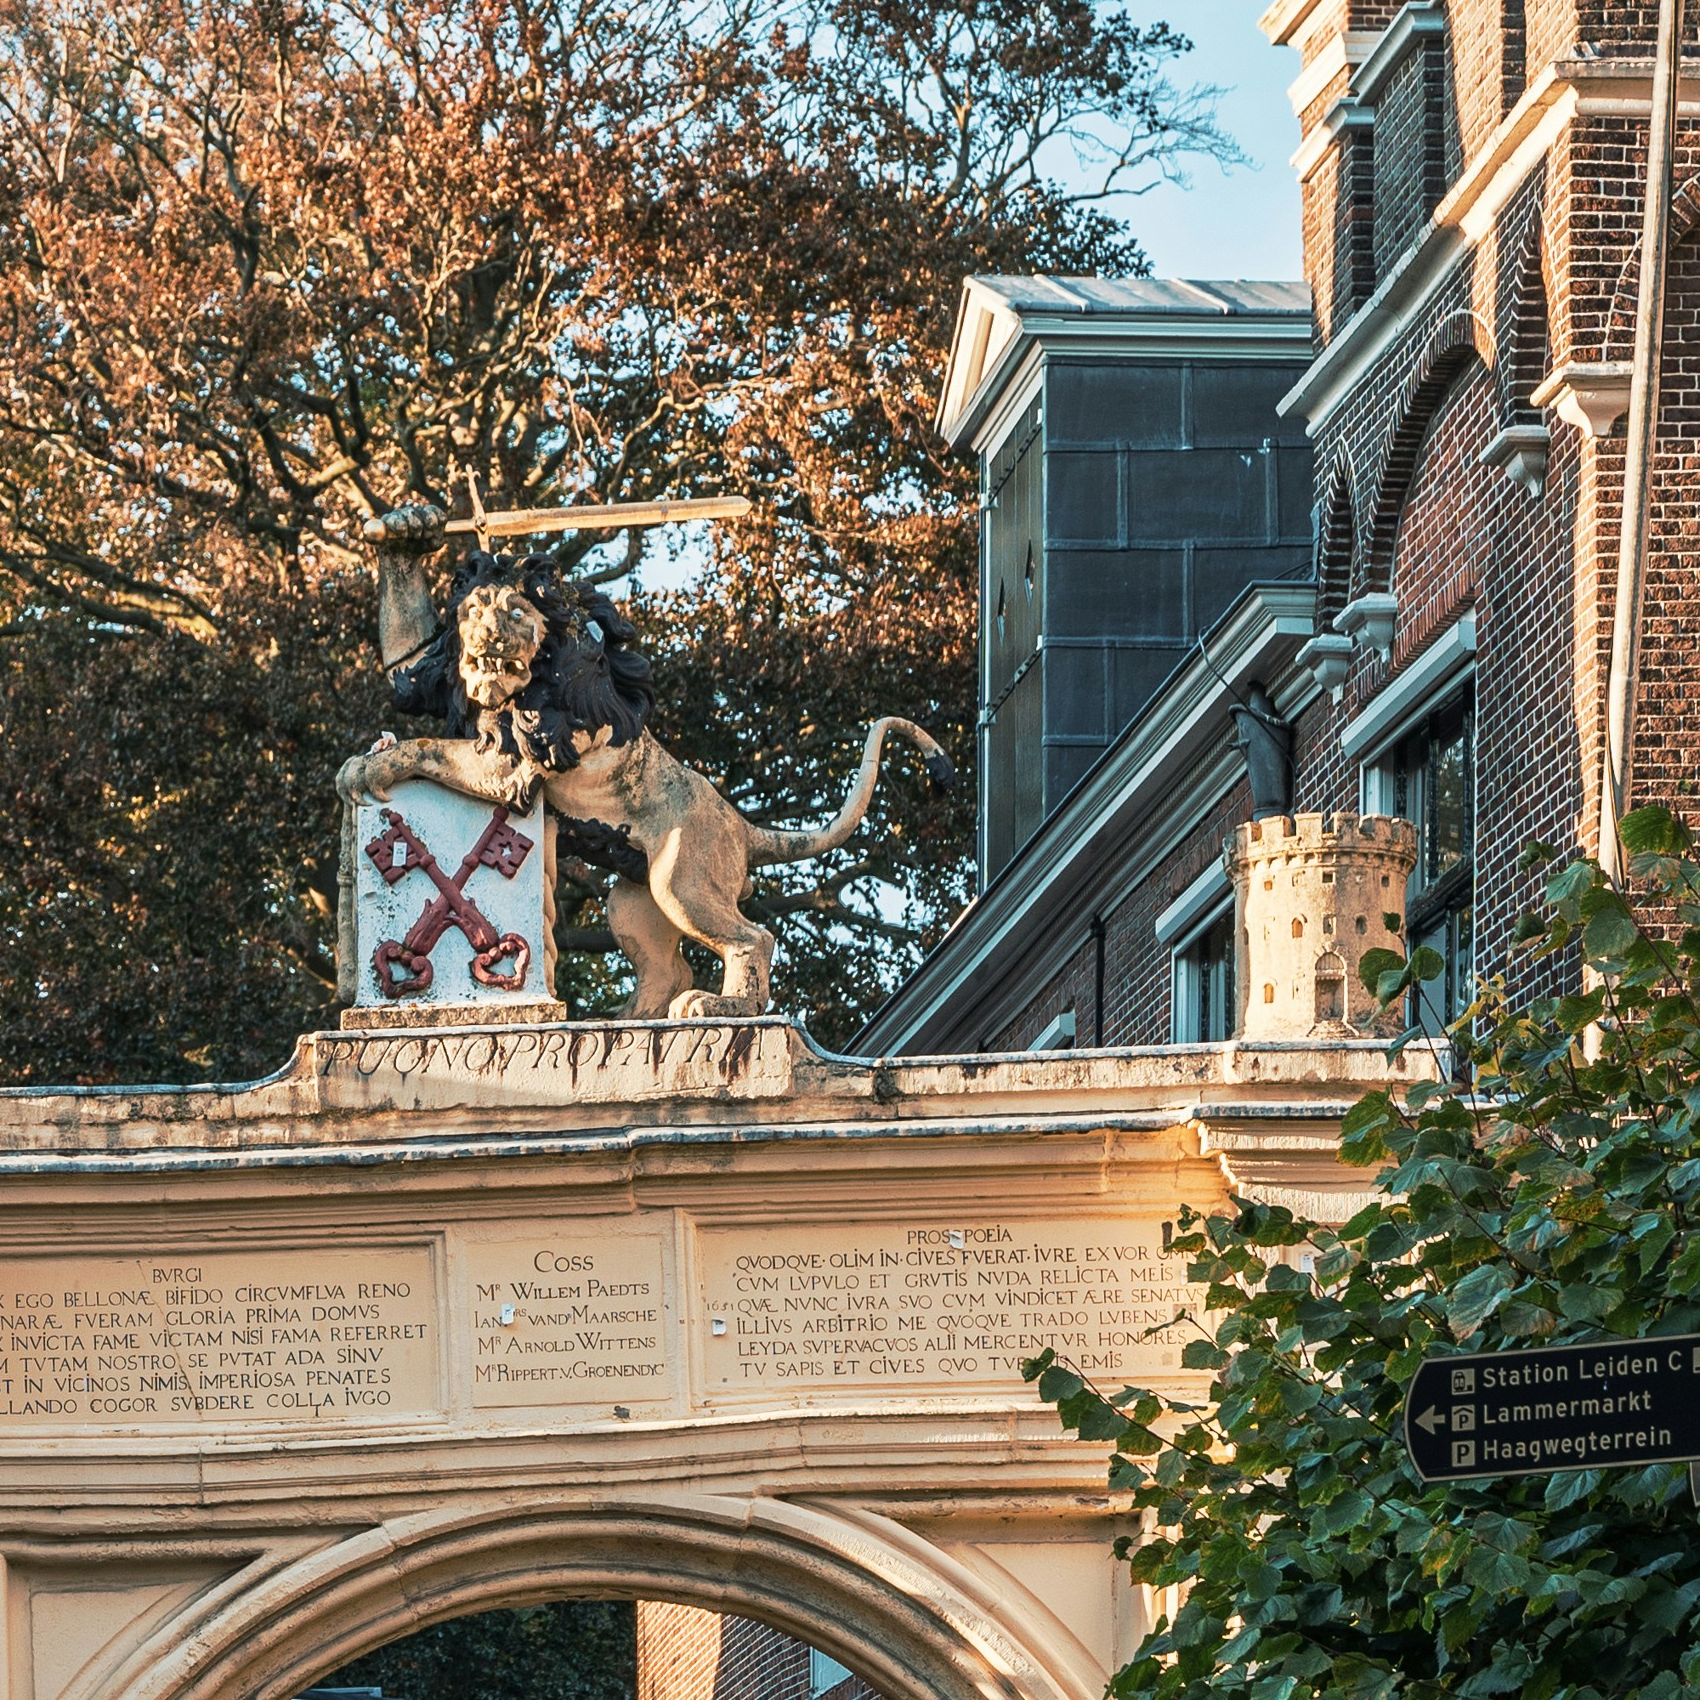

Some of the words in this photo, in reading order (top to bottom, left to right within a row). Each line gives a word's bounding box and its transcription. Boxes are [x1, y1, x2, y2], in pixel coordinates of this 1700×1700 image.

[907, 1225, 1013, 1245] PROSPOEIA
[152, 1268, 202, 1284] BVRGI
[736, 1277, 779, 1292] CVM
[789, 1275, 860, 1291] LVPVLO
[869, 1274, 890, 1288] ET
[977, 1271, 1031, 1286] NVDA
[15, 1293, 54, 1309] EGO
[358, 1282, 411, 1299] RENO
[784, 1296, 838, 1312] NVNC
[898, 1294, 933, 1309] SVO
[942, 1293, 985, 1308] CVM
[1131, 1288, 1205, 1303] SENATVS
[74, 1312, 153, 1329] FVERAM
[312, 1304, 380, 1322] DOMVS
[898, 1316, 927, 1331] ME
[936, 1313, 1012, 1332] QVOQVE
[1020, 1311, 1089, 1327] TRADO
[1099, 1309, 1168, 1325] LVBENS
[93, 1333, 140, 1350] FAME
[272, 1328, 322, 1344] FAMA
[330, 1324, 427, 1342] REFERRET
[738, 1340, 797, 1357] LEYDA
[803, 1338, 918, 1354] SVPERVACVOS
[964, 1333, 1088, 1350] MERCENTVR
[1098, 1330, 1187, 1346] HONORES
[20, 1356, 88, 1373] TVTAM
[98, 1354, 176, 1371] NOSTRO
[188, 1353, 208, 1368] SE
[219, 1351, 276, 1367] PVTAT
[285, 1350, 325, 1366] ADA
[740, 1362, 766, 1377] TV
[776, 1361, 824, 1376] SAPIS
[833, 1360, 860, 1375] ET
[938, 1357, 978, 1375] QVO
[1483, 1364, 1569, 1389] Station
[1579, 1356, 1658, 1379] Leiden
[1668, 1351, 1683, 1371] C
[306, 1368, 391, 1386] PENATES
[90, 1398, 158, 1413] COGOR
[266, 1392, 335, 1408] COLLA
[1483, 1390, 1652, 1424] Lammermarkt
[1483, 1427, 1672, 1462] Haagwegterrein
